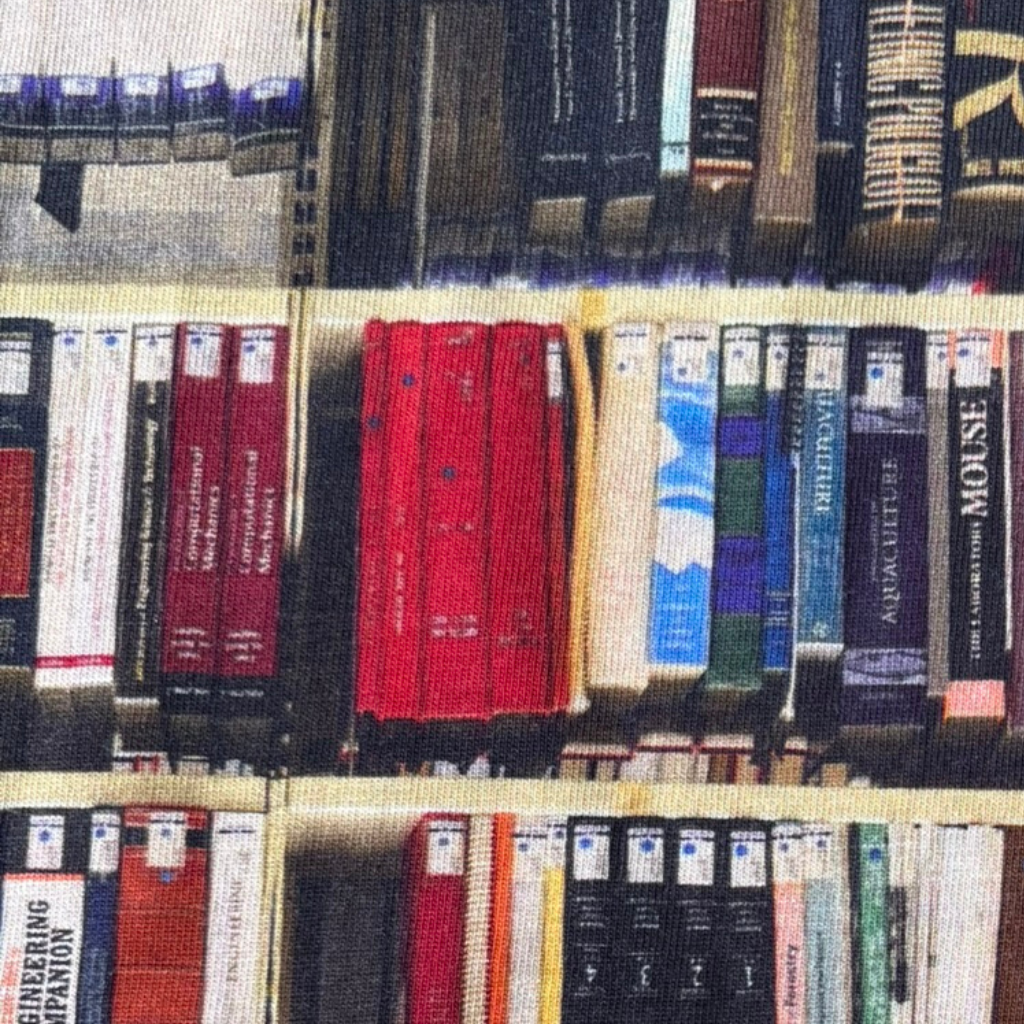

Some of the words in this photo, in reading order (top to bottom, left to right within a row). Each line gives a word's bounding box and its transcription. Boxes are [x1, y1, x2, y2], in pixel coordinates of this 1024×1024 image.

[181, 445, 204, 572] Computational
[239, 449, 259, 574] Computational
[959, 398, 988, 519] MOUSE
[202, 485, 221, 571] Mechanics
[878, 457, 899, 625] AQUACULTURE
[969, 520, 982, 631] LABORATORY
[782, 944, 799, 1008] Forestry
